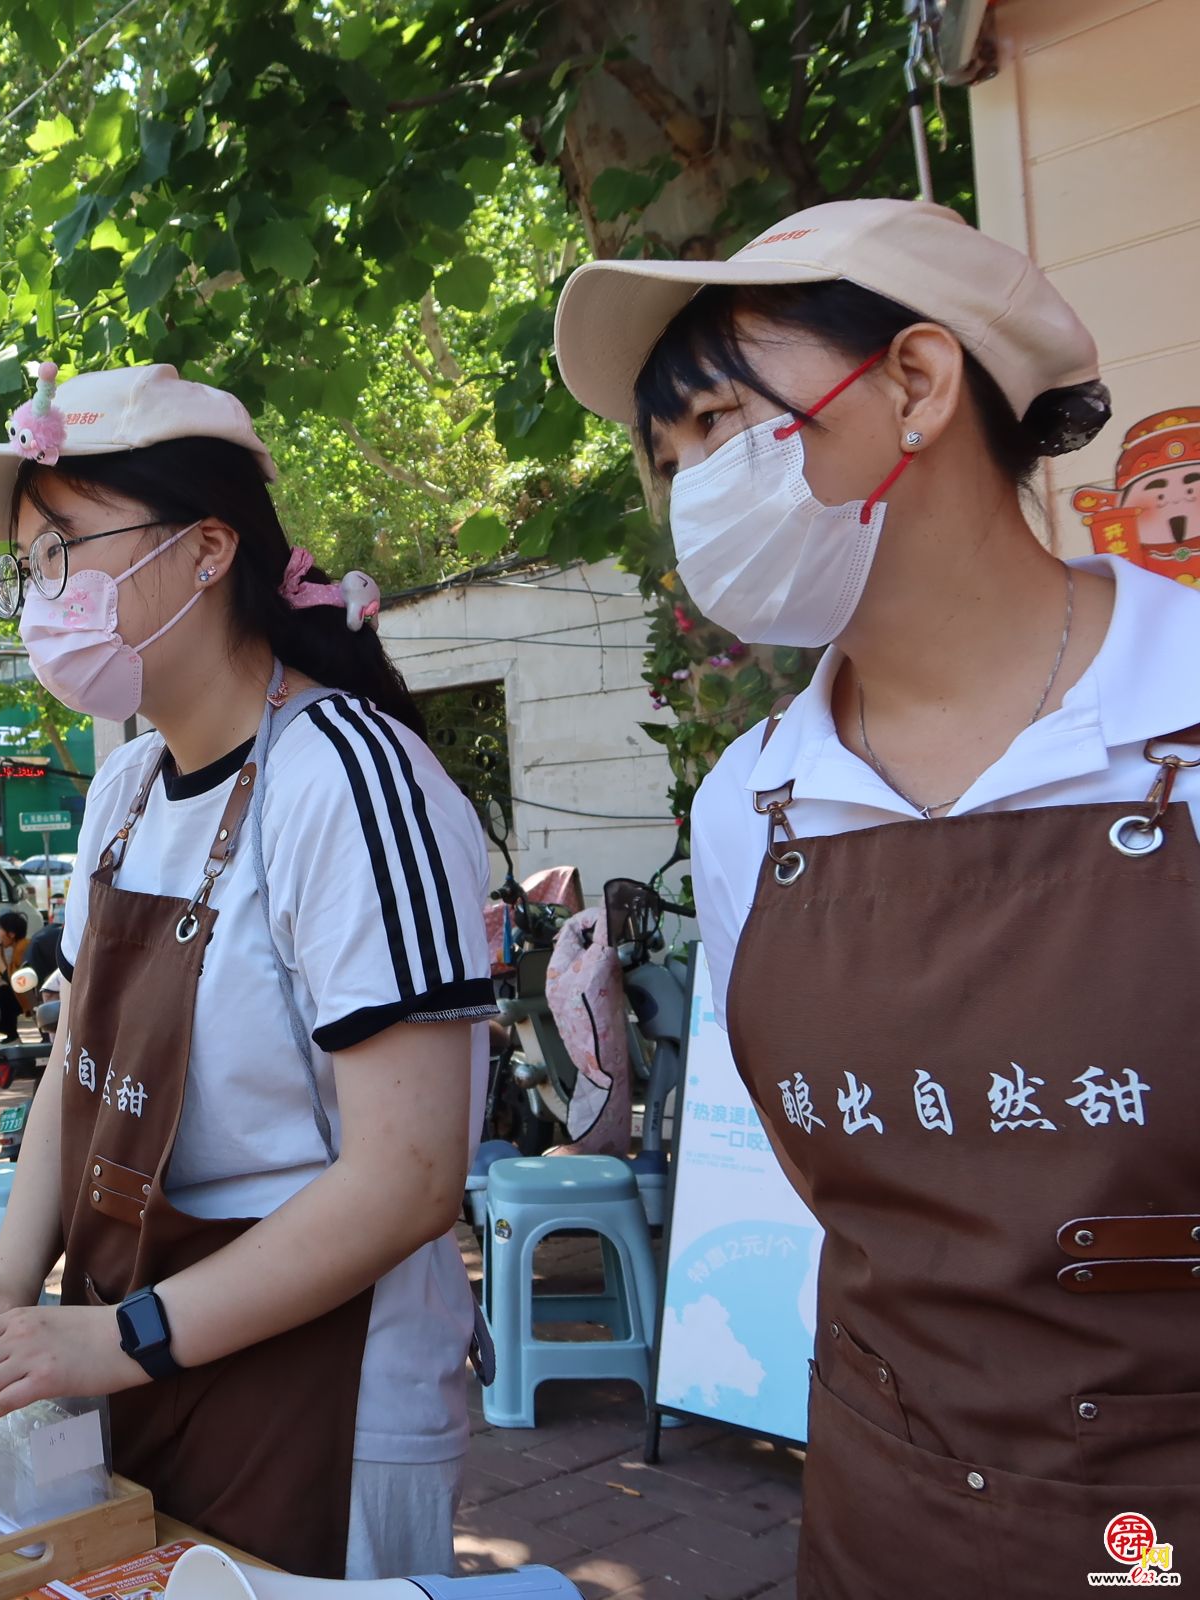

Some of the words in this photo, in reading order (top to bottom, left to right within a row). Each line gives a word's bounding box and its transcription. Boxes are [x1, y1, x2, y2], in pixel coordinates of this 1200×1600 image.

[777, 1062, 1152, 1135] 酿出自然甜
